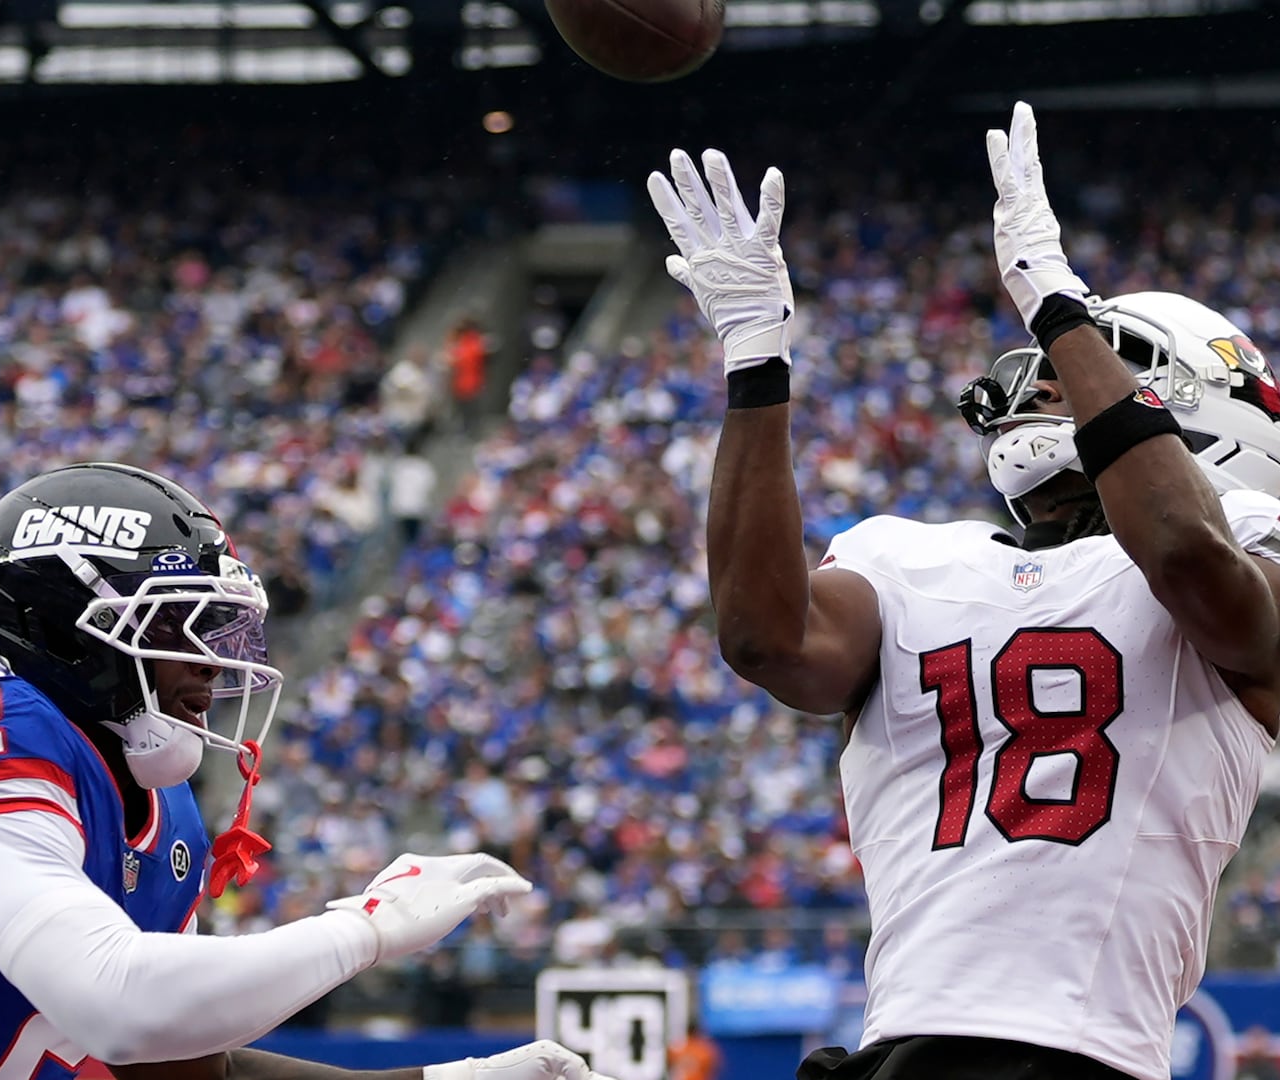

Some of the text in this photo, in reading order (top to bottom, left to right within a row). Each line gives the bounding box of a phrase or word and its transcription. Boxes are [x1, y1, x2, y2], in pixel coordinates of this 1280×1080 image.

[12, 506, 152, 549] GIANTS
[152, 563, 194, 571] OAKLEY
[1017, 573, 1038, 585] NFL
[919, 627, 1124, 851] 18
